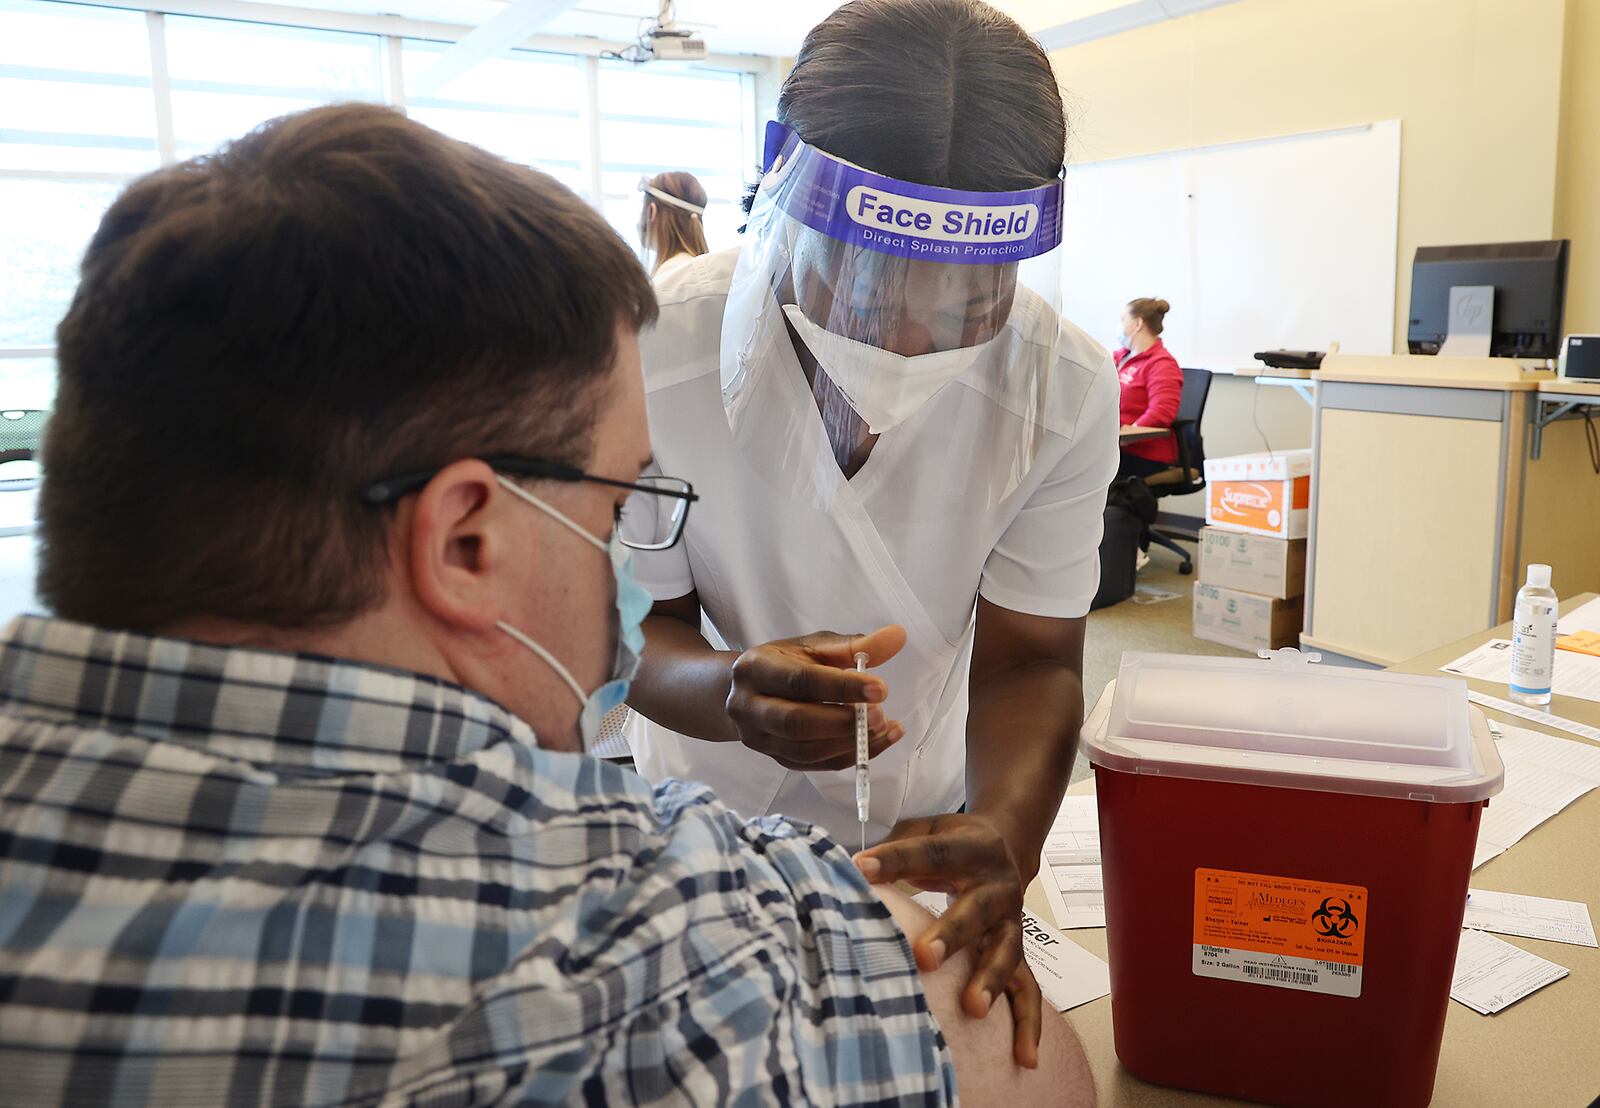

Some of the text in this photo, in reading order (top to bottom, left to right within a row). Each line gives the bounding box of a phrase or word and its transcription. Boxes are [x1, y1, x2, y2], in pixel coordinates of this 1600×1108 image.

[858, 192, 932, 231] Face
[942, 210, 1030, 236] Shield
[863, 229, 1024, 256] Direct Splash Protection
[1224, 487, 1268, 508] Supreme
[1317, 938, 1352, 946] BIOHAZARD
